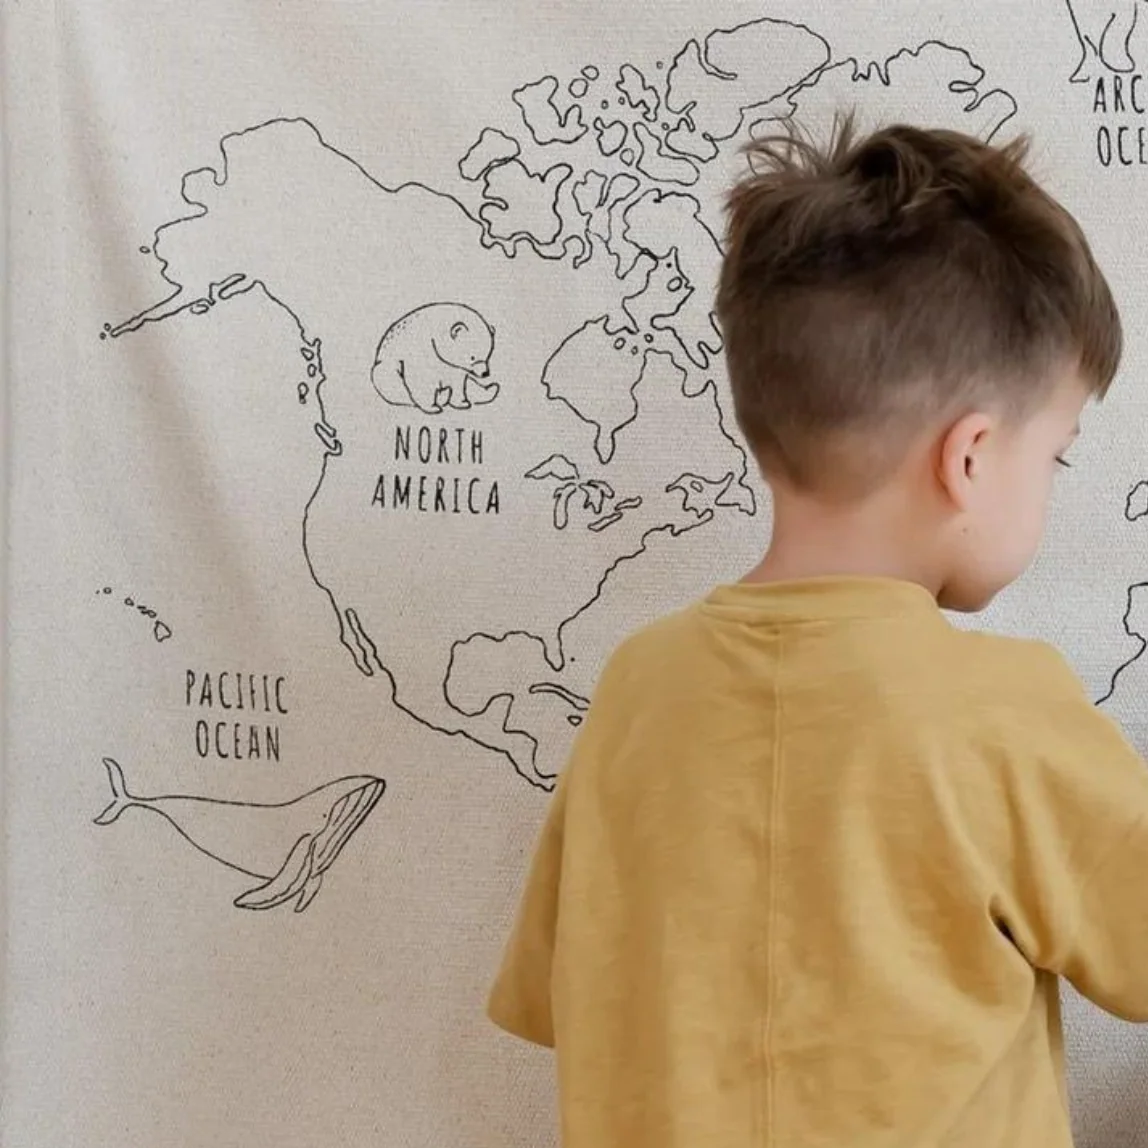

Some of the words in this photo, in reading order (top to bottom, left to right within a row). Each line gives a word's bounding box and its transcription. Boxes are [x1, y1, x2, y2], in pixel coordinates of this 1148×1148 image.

[395, 426, 482, 464] NORTH
[372, 475, 499, 514] AMERICA
[186, 669, 288, 714] PACIFIC
[196, 720, 279, 762] OCEAN
